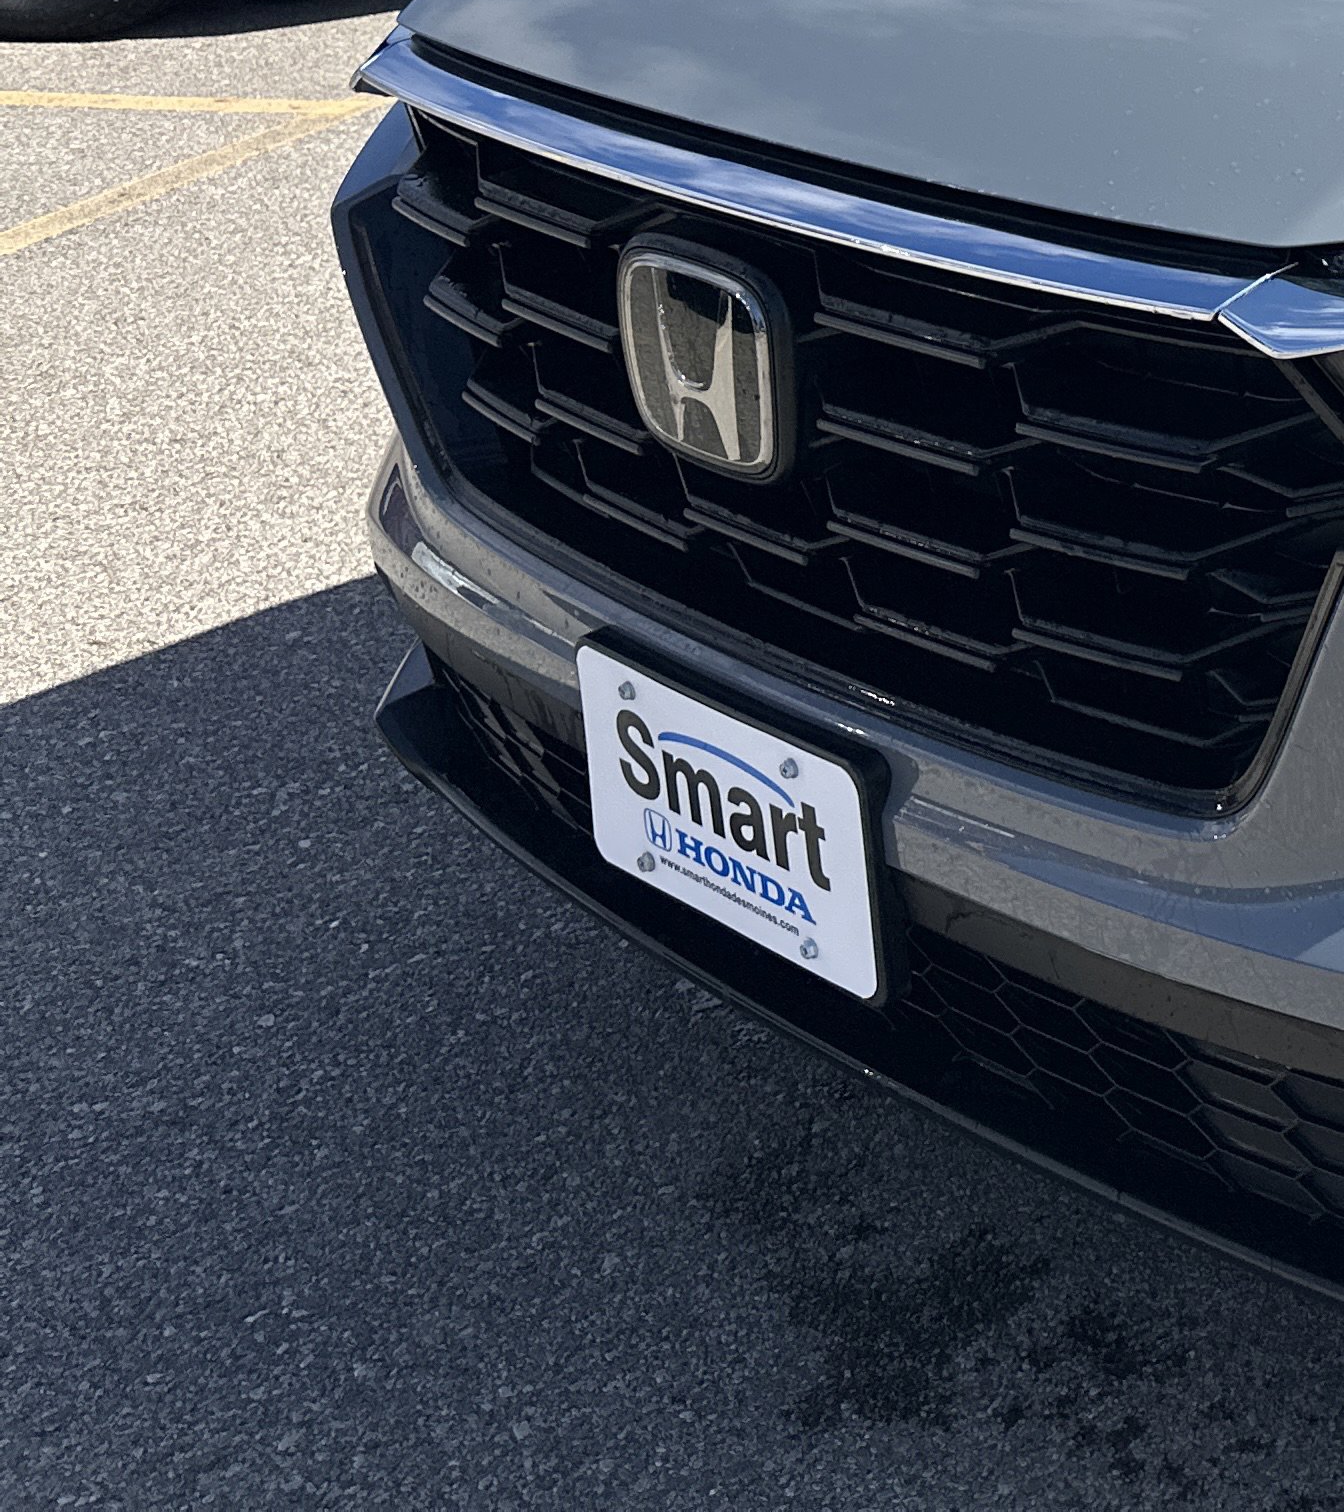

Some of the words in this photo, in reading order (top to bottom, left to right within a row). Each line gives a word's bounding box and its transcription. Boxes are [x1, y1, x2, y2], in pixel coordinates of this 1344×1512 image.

[616, 709, 831, 891] Smart
[660, 855, 800, 936] www.smarthondadesmoines.com
[675, 827, 817, 926] HONDA
